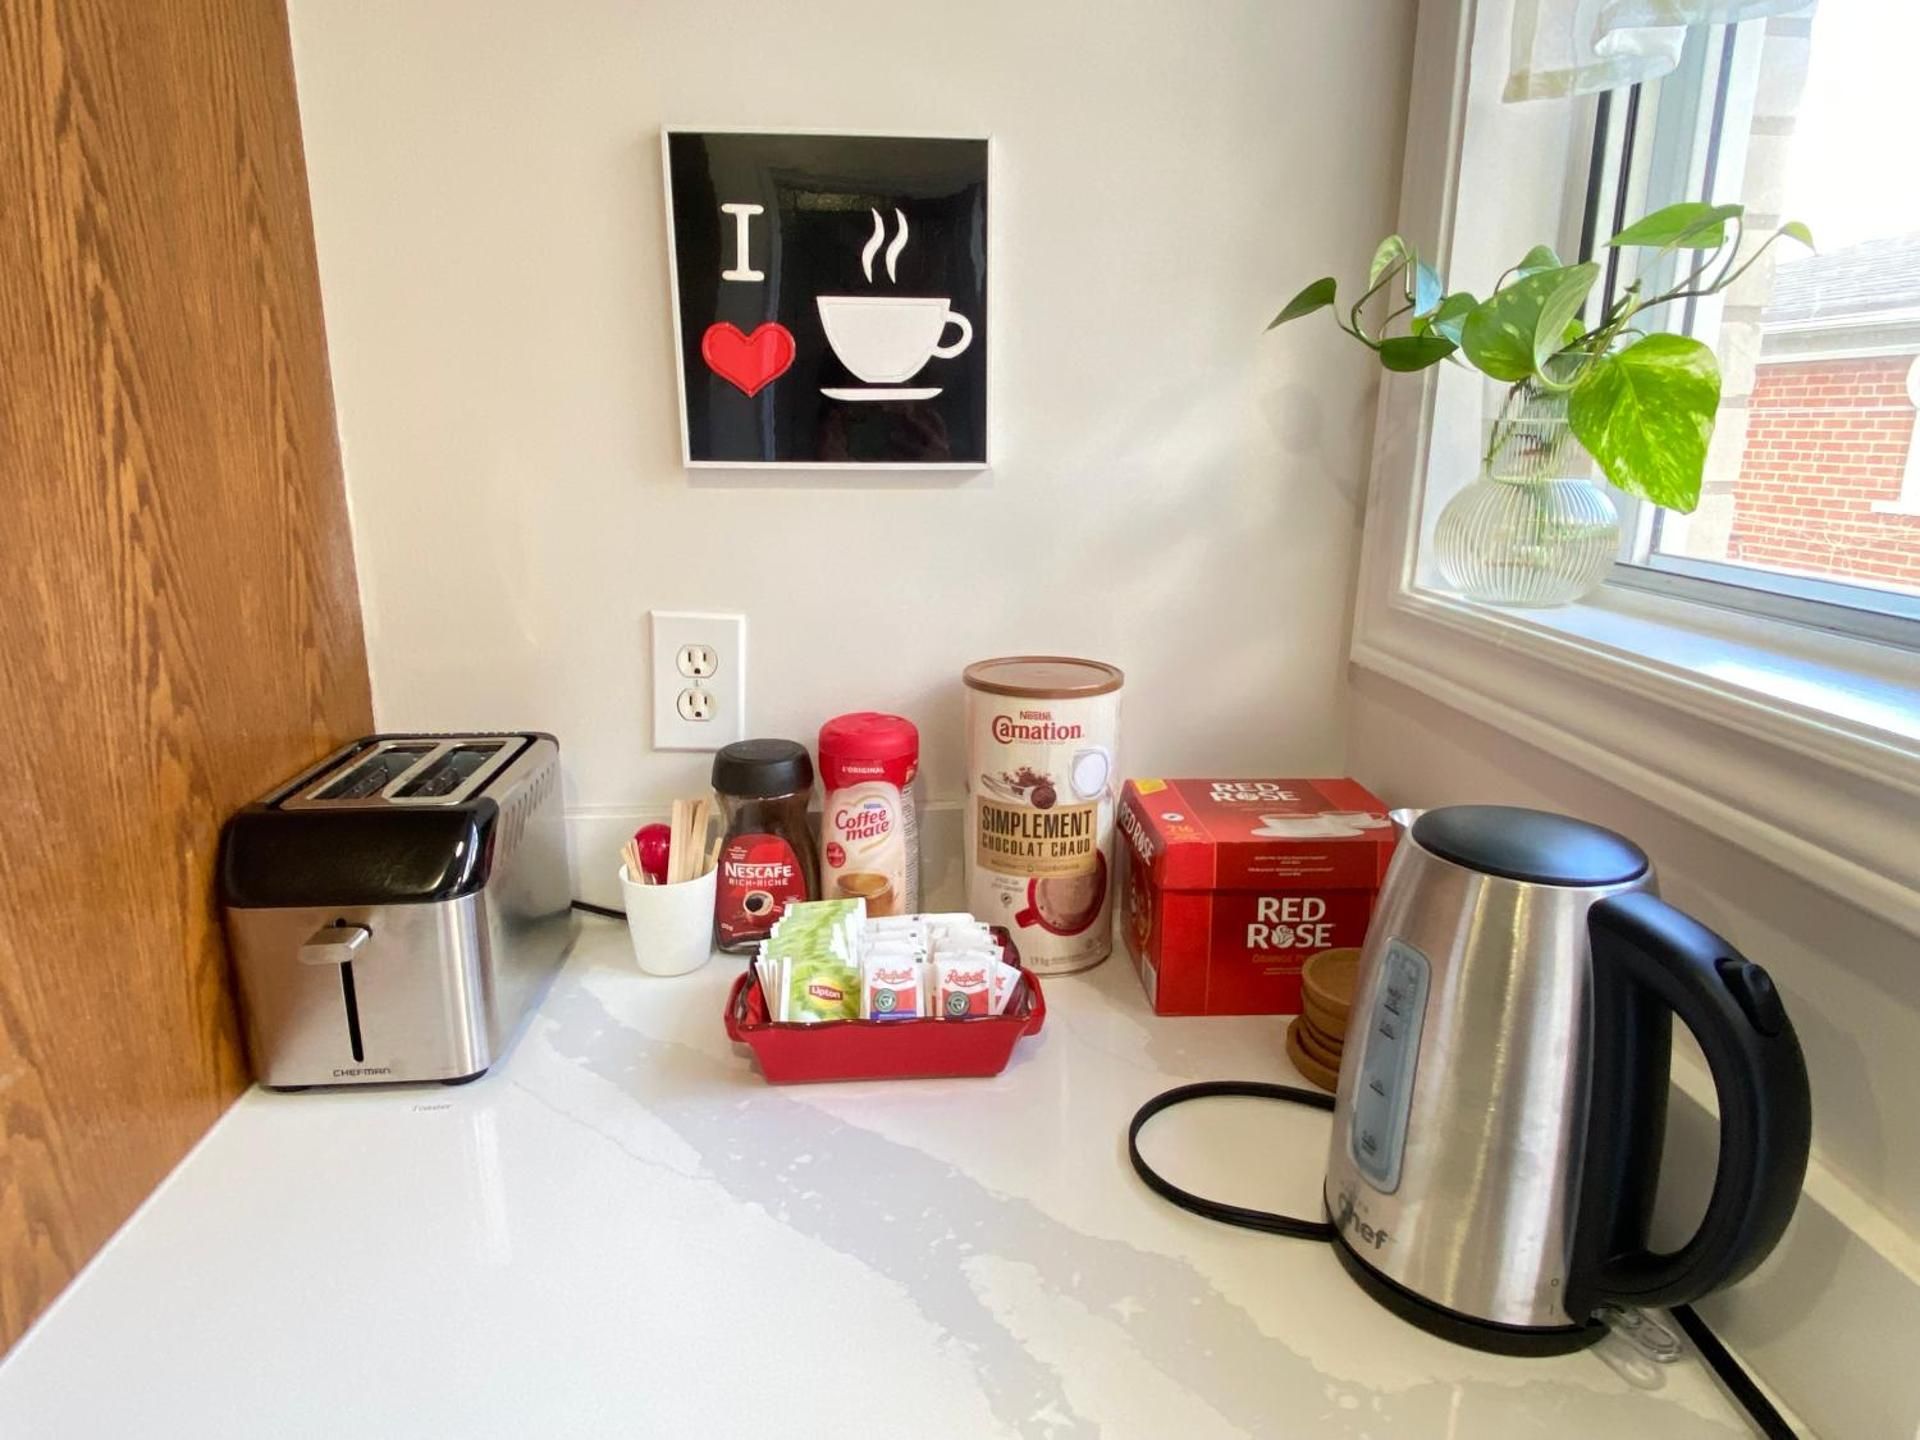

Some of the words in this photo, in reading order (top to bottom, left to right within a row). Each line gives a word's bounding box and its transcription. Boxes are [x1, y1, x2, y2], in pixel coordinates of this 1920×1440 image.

[721, 203, 765, 282] I
[991, 714, 1082, 745] Carnation
[1209, 791, 1302, 802] ROSE
[1211, 782, 1280, 792] RED
[835, 809, 887, 830] Coffee
[846, 820, 890, 842] mate
[982, 805, 1093, 840] SIMPLEMENT
[981, 832, 1045, 858] CHOCOLAT
[1051, 838, 1092, 858] CHAUD
[1257, 896, 1327, 923] RED
[1246, 923, 1336, 949] ROSE
[811, 986, 841, 999] Lipton
[332, 1066, 392, 1078] CHEFMAN
